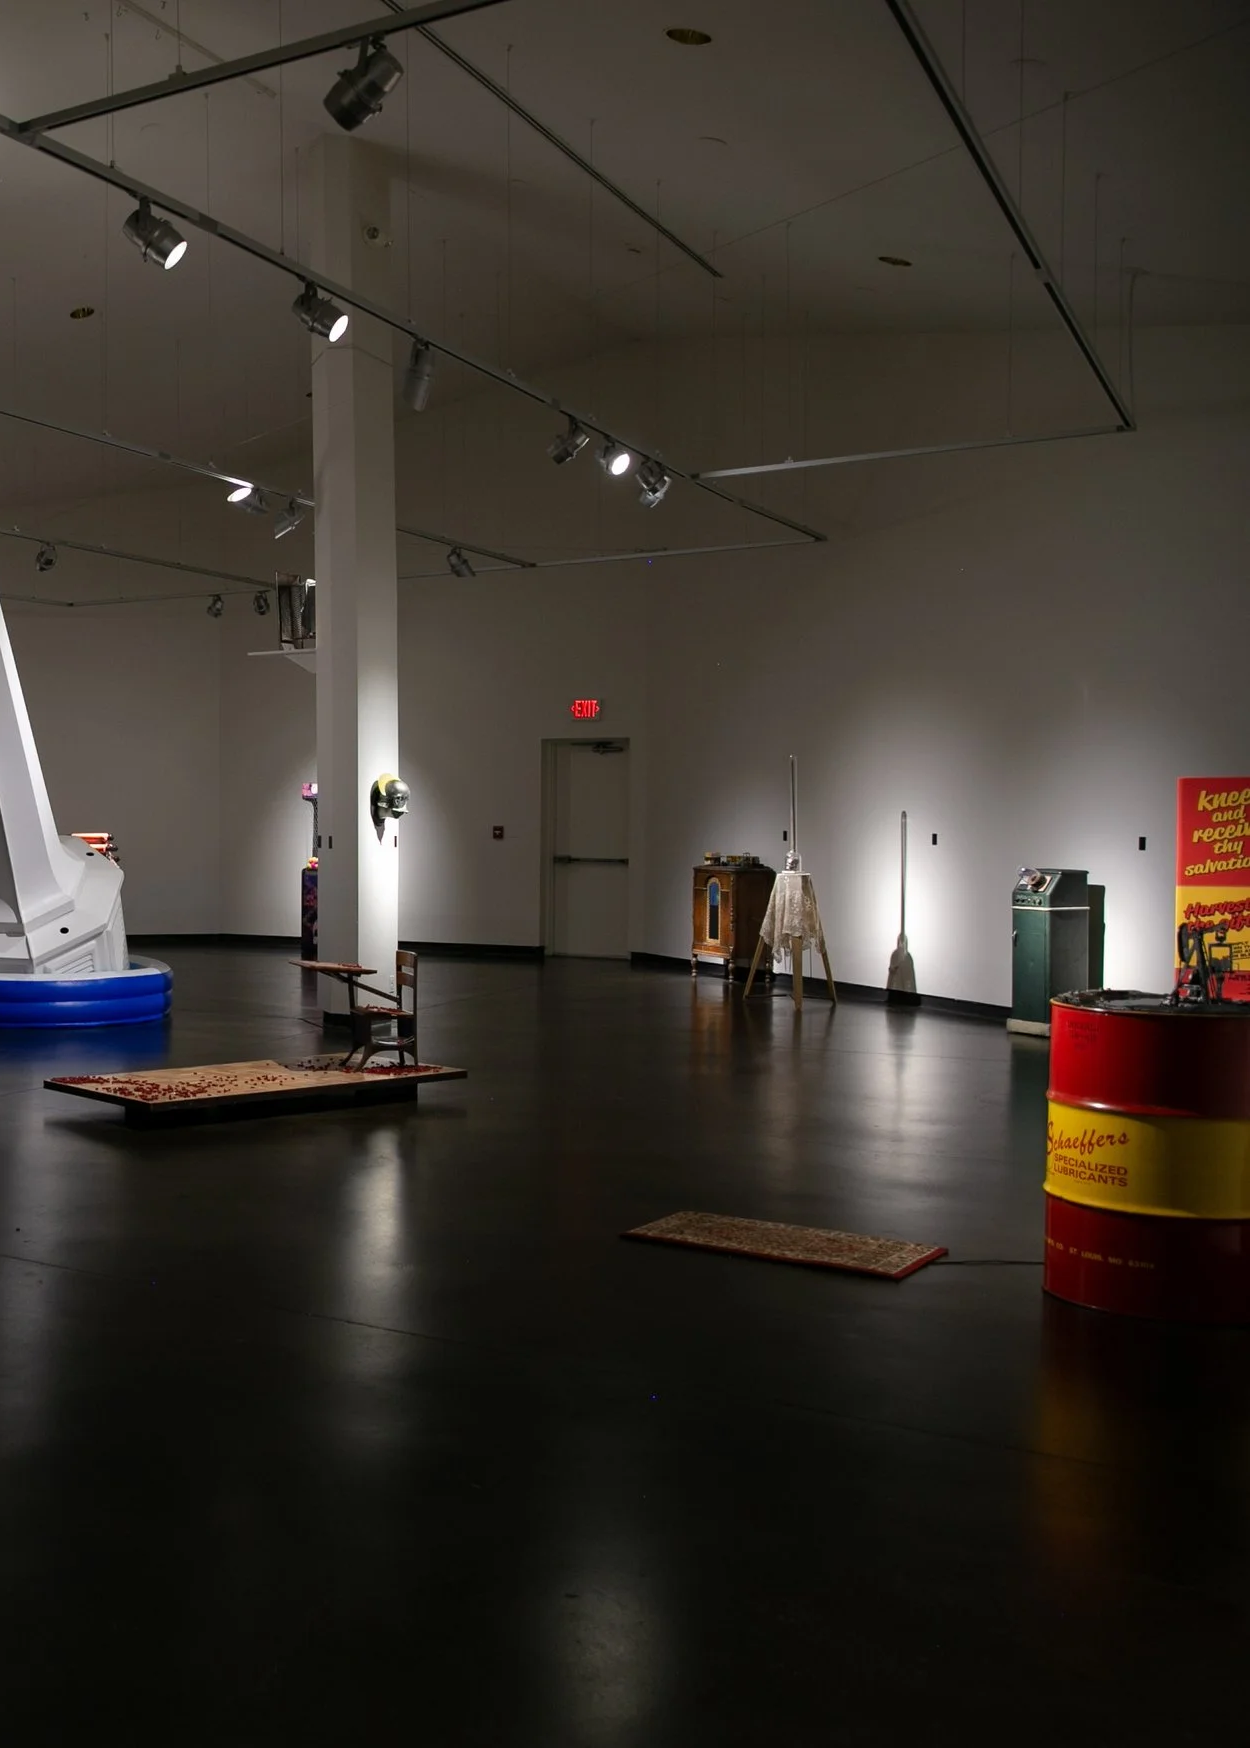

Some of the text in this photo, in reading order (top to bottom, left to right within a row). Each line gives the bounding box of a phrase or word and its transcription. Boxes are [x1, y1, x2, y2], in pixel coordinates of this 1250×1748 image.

[575, 700, 597, 718] EXIT
[1212, 805, 1246, 822] and
[1213, 839, 1243, 854] thy
[1054, 1154, 1127, 1175] SPECIALIZED
[1053, 1164, 1128, 1187] LUBRICANTS
